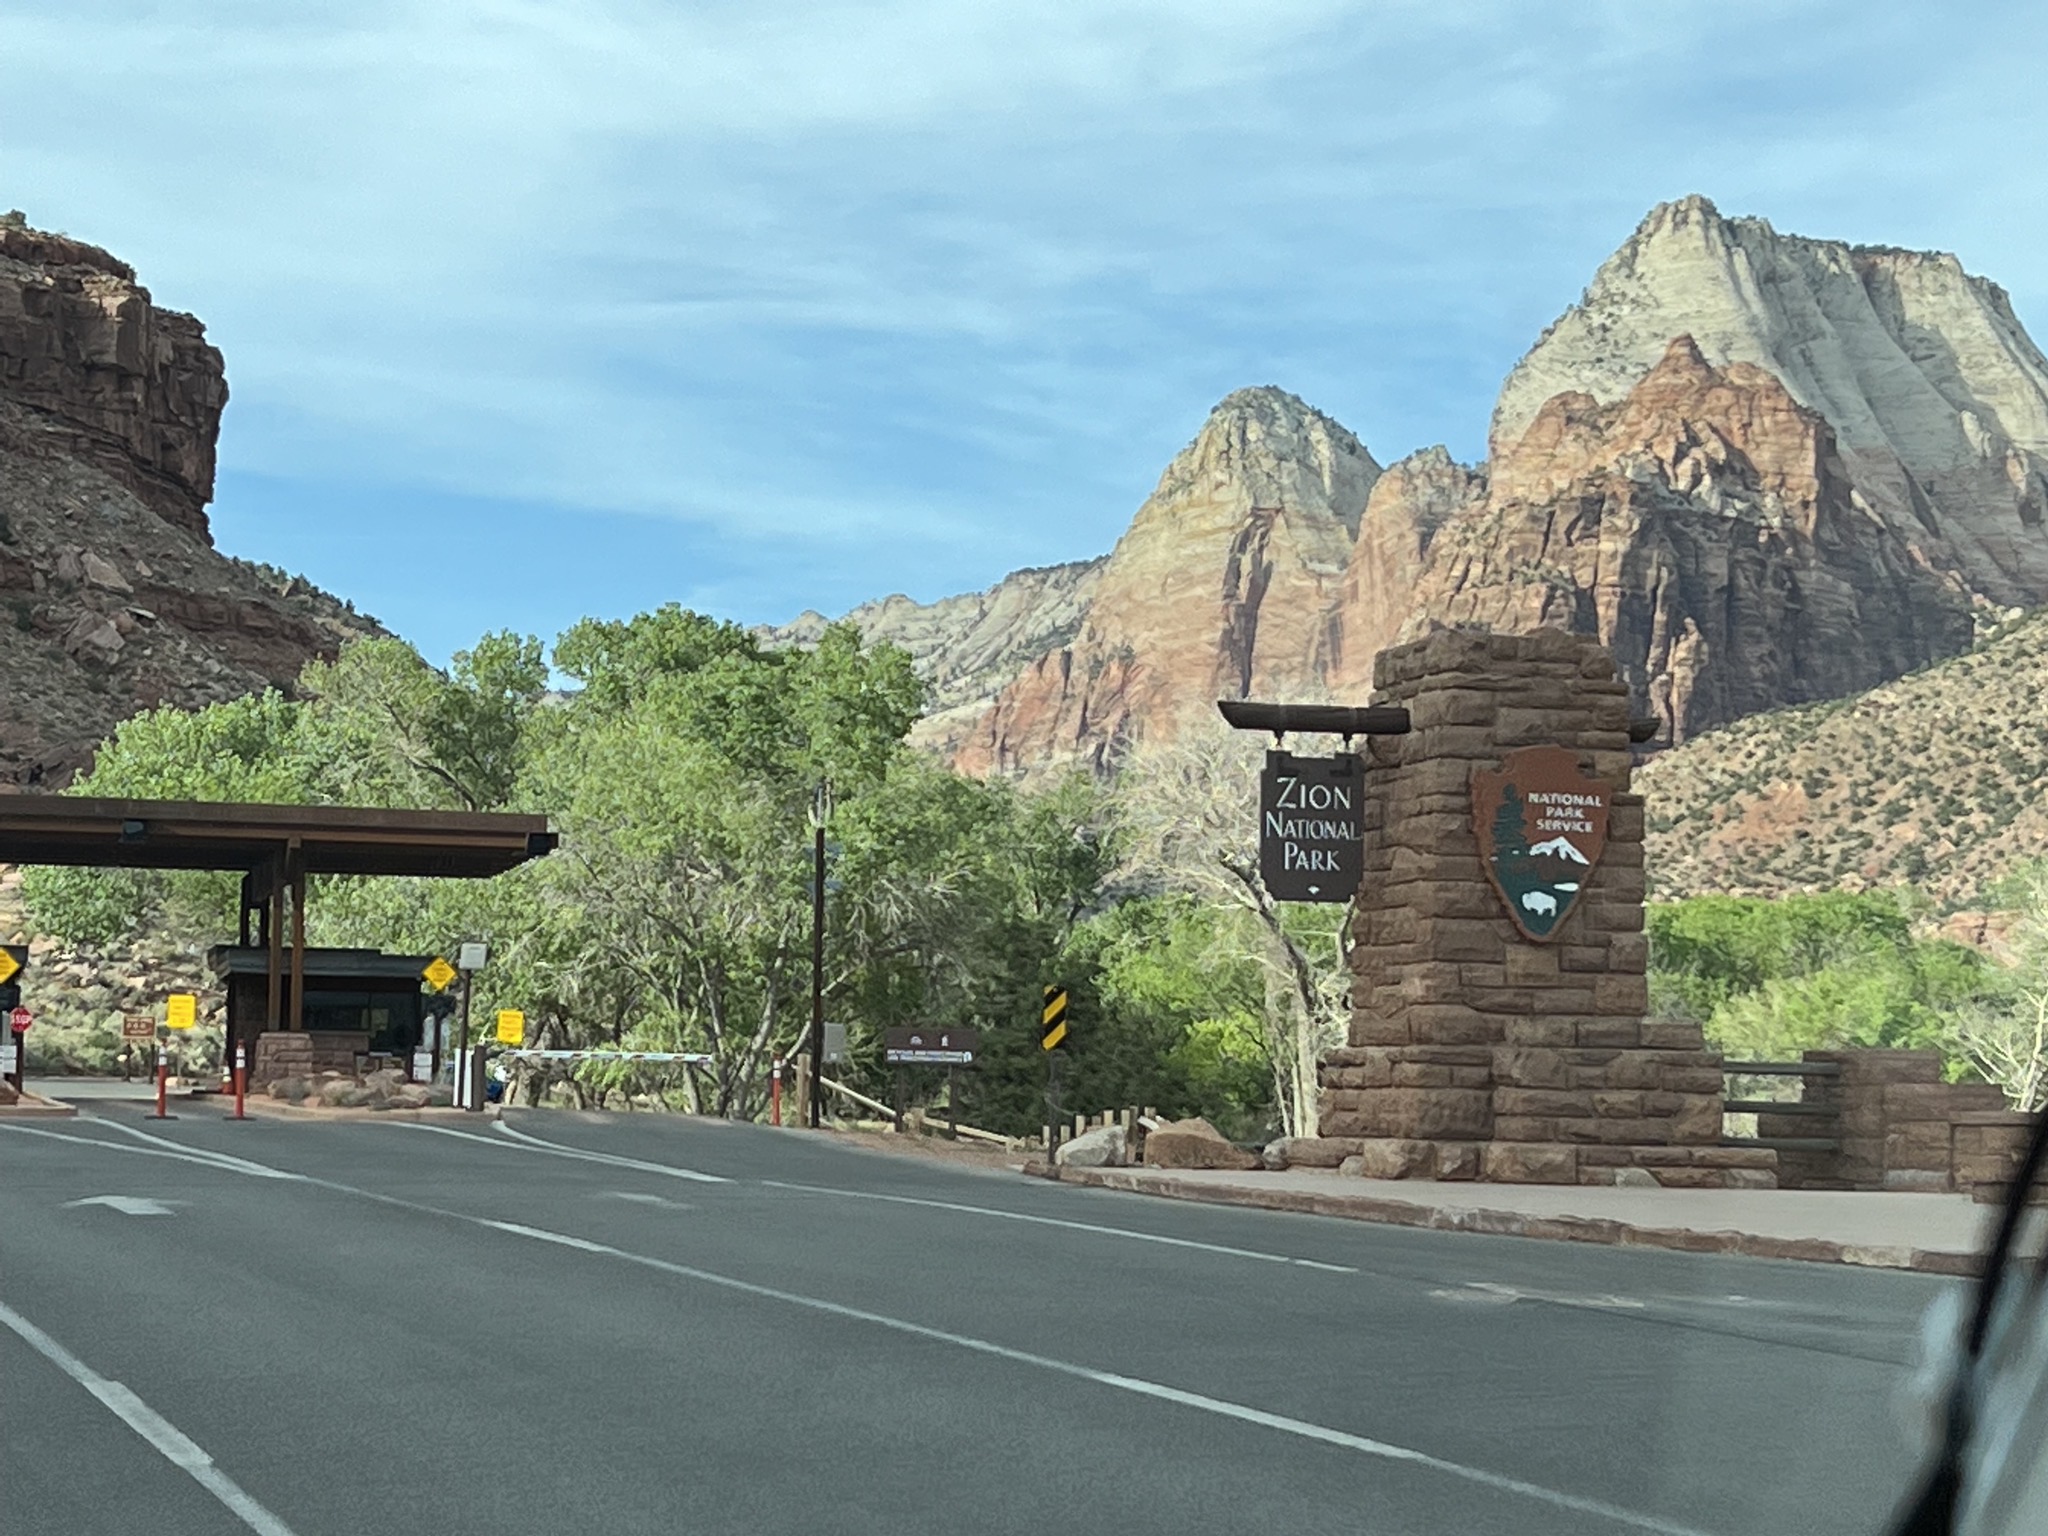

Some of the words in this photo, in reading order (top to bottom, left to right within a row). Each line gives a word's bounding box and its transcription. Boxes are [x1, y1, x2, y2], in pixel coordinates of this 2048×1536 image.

[1276, 777, 1351, 809] ZION
[1528, 792, 1602, 807] NATIONAL
[1545, 806, 1585, 819] PARK
[1265, 810, 1362, 840] NATIONAL
[1536, 818, 1594, 833] SERVICE
[1284, 842, 1341, 872] PARK
